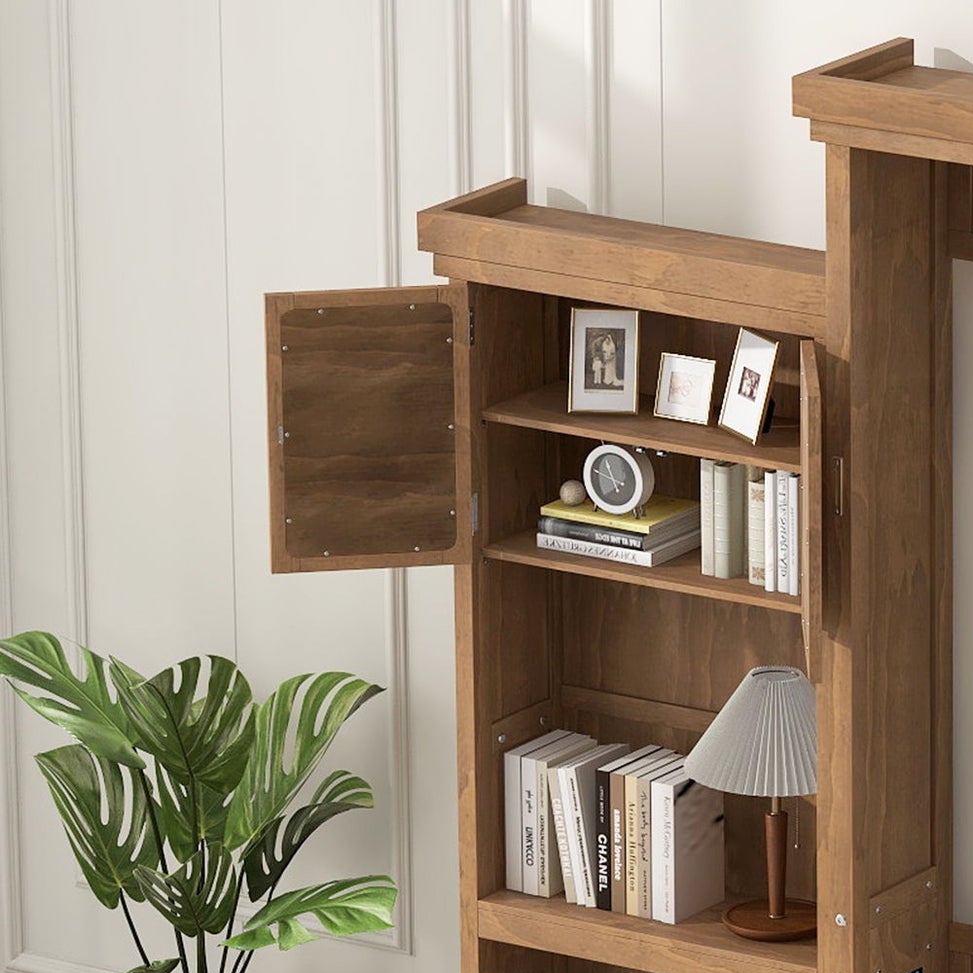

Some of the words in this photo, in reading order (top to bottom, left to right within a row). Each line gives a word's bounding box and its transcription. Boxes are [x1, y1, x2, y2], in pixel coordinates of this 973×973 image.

[613, 808, 622, 844] amanda
[628, 801, 636, 838] Arianna
[597, 833, 608, 892] CHANEL
[614, 844, 622, 881] lovelace
[628, 841, 637, 892] Huffington
